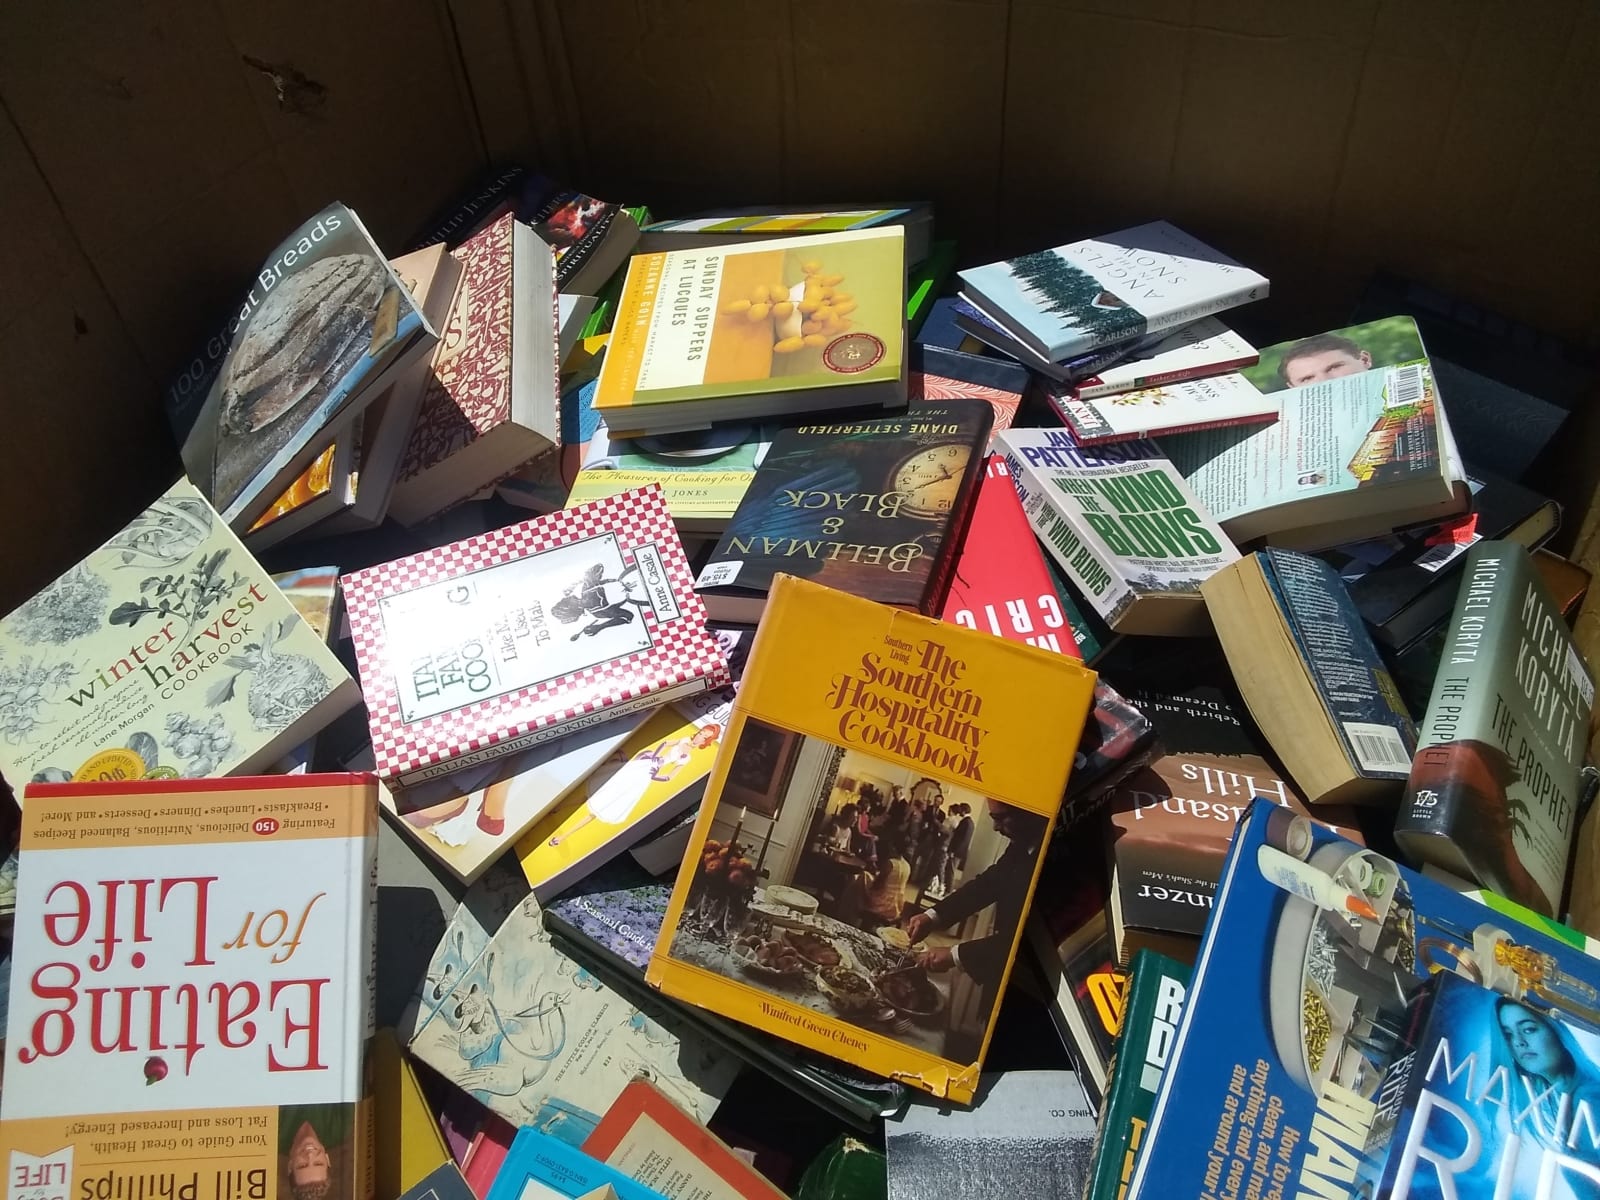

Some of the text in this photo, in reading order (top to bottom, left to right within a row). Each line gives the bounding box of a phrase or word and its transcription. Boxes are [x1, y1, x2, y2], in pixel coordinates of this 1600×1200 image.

[556, 208, 616, 281] SPIRITUALITY
[1116, 247, 1187, 284] SNOW
[637, 255, 662, 326] SUZANNE GOIN
[671, 259, 697, 327] AT LUCQUES
[1073, 247, 1164, 299] ANGELS
[168, 358, 206, 402] 100
[206, 283, 262, 362] Great
[257, 212, 343, 294] Breads
[687, 256, 720, 361] SUNDAY SUPPERS
[797, 424, 958, 434] DIANE SETTERFIELD
[1072, 405, 1100, 429] JAN
[928, 453, 936, 462] 5
[948, 448, 958, 458] 6
[1005, 452, 1024, 478] JAMES
[581, 472, 737, 484] The Pleasures of Cooking for
[902, 477, 912, 485] 3
[1051, 469, 1187, 514] WHEN WIND
[781, 489, 911, 519] BLACK
[822, 517, 845, 535] &
[938, 499, 952, 509] 12
[1041, 501, 1057, 522] WHEN
[1073, 495, 1105, 512] THE
[724, 536, 924, 573] BELLMAN
[1048, 518, 1080, 559] WIND
[1082, 507, 1223, 559] BLOWS
[641, 552, 673, 613] Anne Casale
[1070, 543, 1112, 597] BLOWS
[140, 582, 269, 690] harvest
[501, 633, 518, 662] Like
[535, 629, 551, 646] To
[883, 634, 914, 652] Southern
[889, 649, 911, 665] Living
[1520, 580, 1582, 721] MICHAEL
[65, 620, 177, 709] winter
[161, 624, 255, 701] COOKBOOK
[861, 651, 984, 717] Southern
[915, 638, 968, 685] The
[1423, 558, 1501, 768] MICHAEL KORYTA THE PROPHET
[825, 677, 990, 751] Hospitality
[1155, 703, 1180, 713] and
[1187, 708, 1241, 726] Rebirth
[1515, 636, 1575, 764] KORYTA
[93, 702, 155, 748] Lane Morgan
[421, 696, 662, 780] ITALIAN FAMILY COOKING Anne Casale
[838, 710, 986, 784] Cookbook
[1181, 762, 1293, 808] Hills
[1492, 693, 1518, 763] THE
[1516, 737, 1573, 841] PROPHET
[33, 818, 336, 841] Featuring 150 Delicious, Nutritious, Balanced Recipes
[40, 801, 323, 822] Breakfasts Lunches Dinners Desserts and More!
[1142, 870, 1208, 887] the Shah's Men
[42, 875, 326, 973] for Life
[570, 895, 582, 907] A
[580, 900, 621, 930] Seasonal
[618, 920, 646, 944] Guide
[18, 962, 331, 1079] Eating
[554, 1068, 566, 1083] THE
[563, 1047, 580, 1070] LITTLE
[577, 1028, 592, 1048] COLOR
[591, 1003, 609, 1028] CLASSICS
[758, 1002, 871, 1052] Winifred Green Cheney
[1370, 1055, 1408, 1129] RIDE
[1389, 1050, 1416, 1121] MAXIMUM
[64, 1117, 268, 1138] Fat Loss and Increased Energy!
[1048, 1109, 1065, 1118] CO.
[1203, 1064, 1247, 1195] and around your
[1234, 1058, 1270, 1161] anything and
[1257, 1095, 1285, 1143] clean,
[90, 1134, 268, 1153] Your Guide to Great Health,
[1252, 1141, 1272, 1178] and
[1273, 1125, 1300, 1182] How to
[15, 1163, 66, 1188] LIFE
[80, 1168, 267, 1200] Bill Phillips
